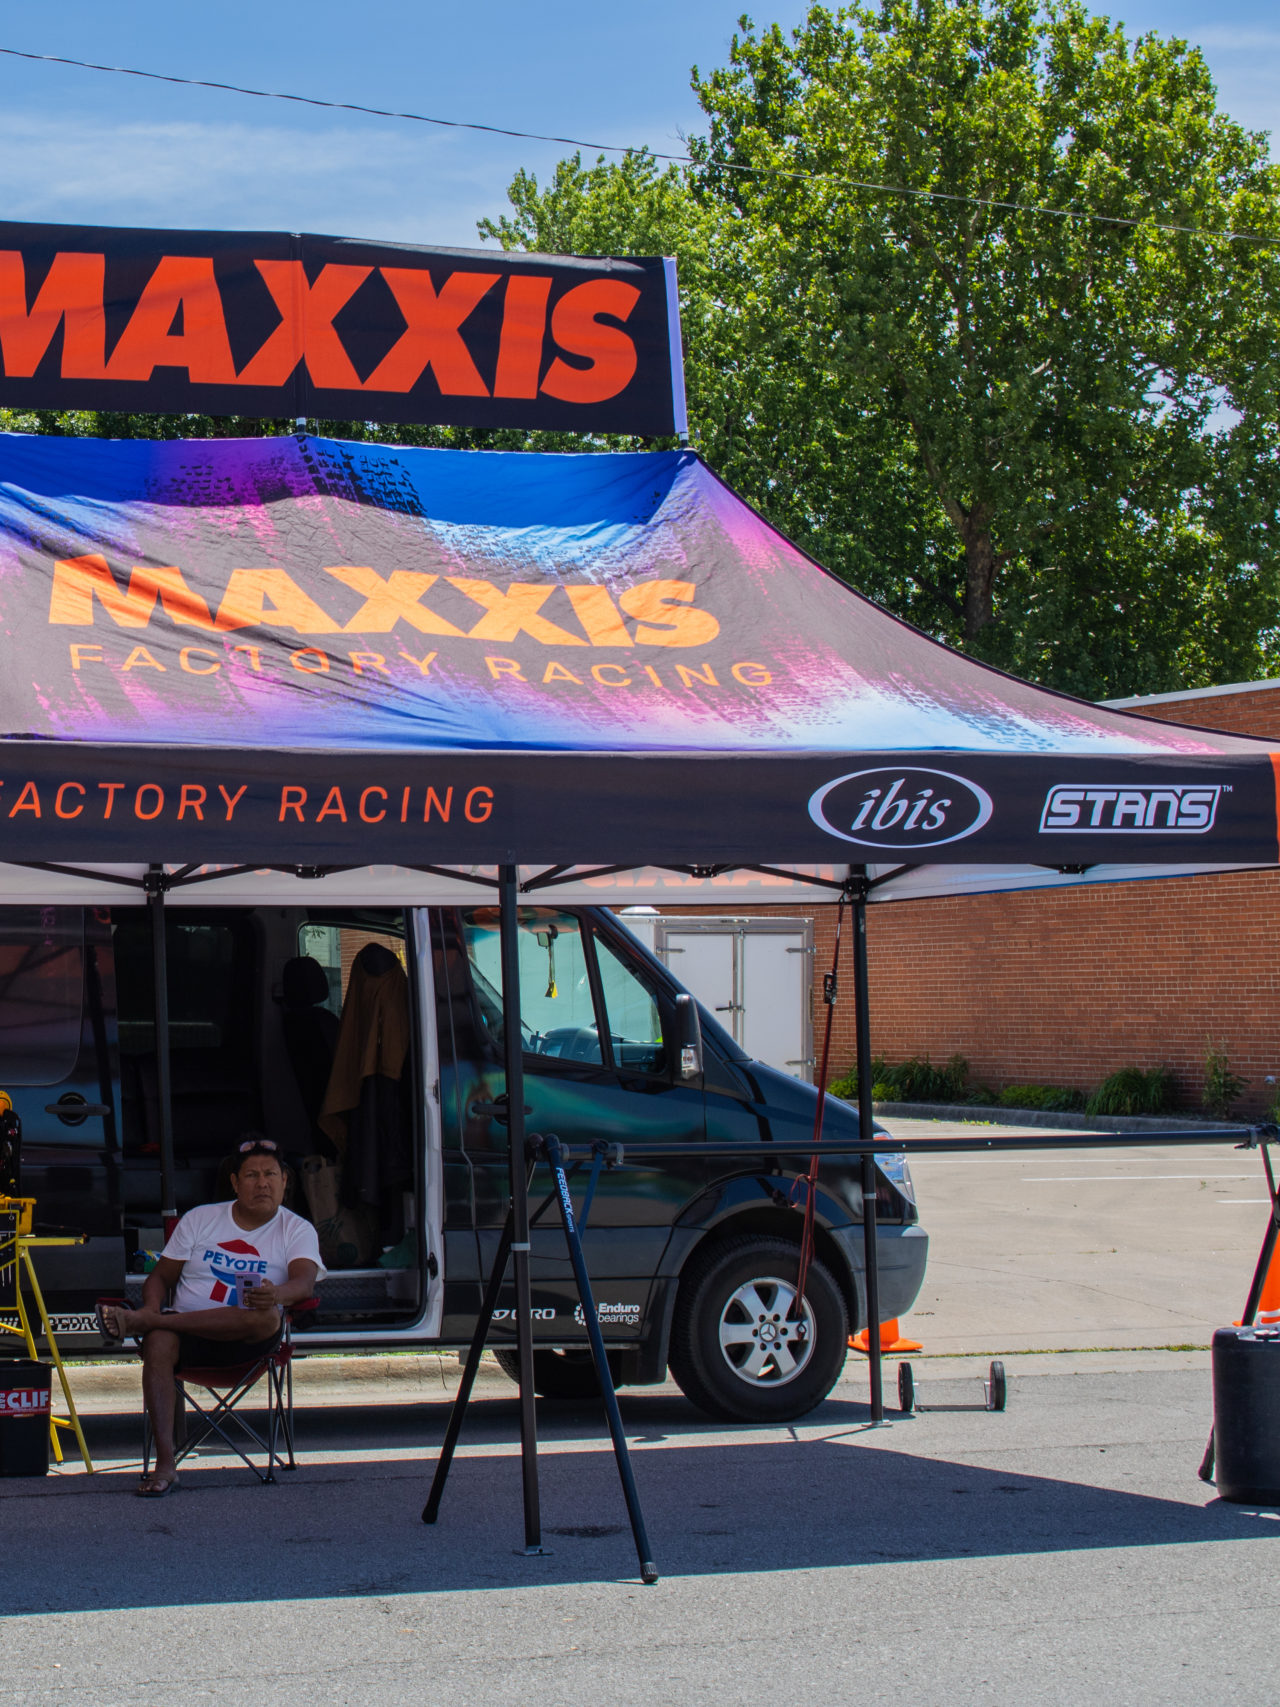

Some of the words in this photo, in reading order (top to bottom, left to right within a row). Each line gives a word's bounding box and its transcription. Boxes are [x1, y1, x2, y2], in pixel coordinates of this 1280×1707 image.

[49, 554, 720, 647] MAXXIS
[69, 642, 438, 677] FACTORY
[486, 657, 773, 689] RACING
[279, 786, 494, 824] RACING
[851, 778, 952, 831] ibis
[556, 1167, 574, 1216] FEEDBACK
[202, 1250, 268, 1274] PEYOTE
[598, 1302, 640, 1313] Enduro
[598, 1313, 640, 1325] bearings
[7, 1390, 49, 1409] CLIF
